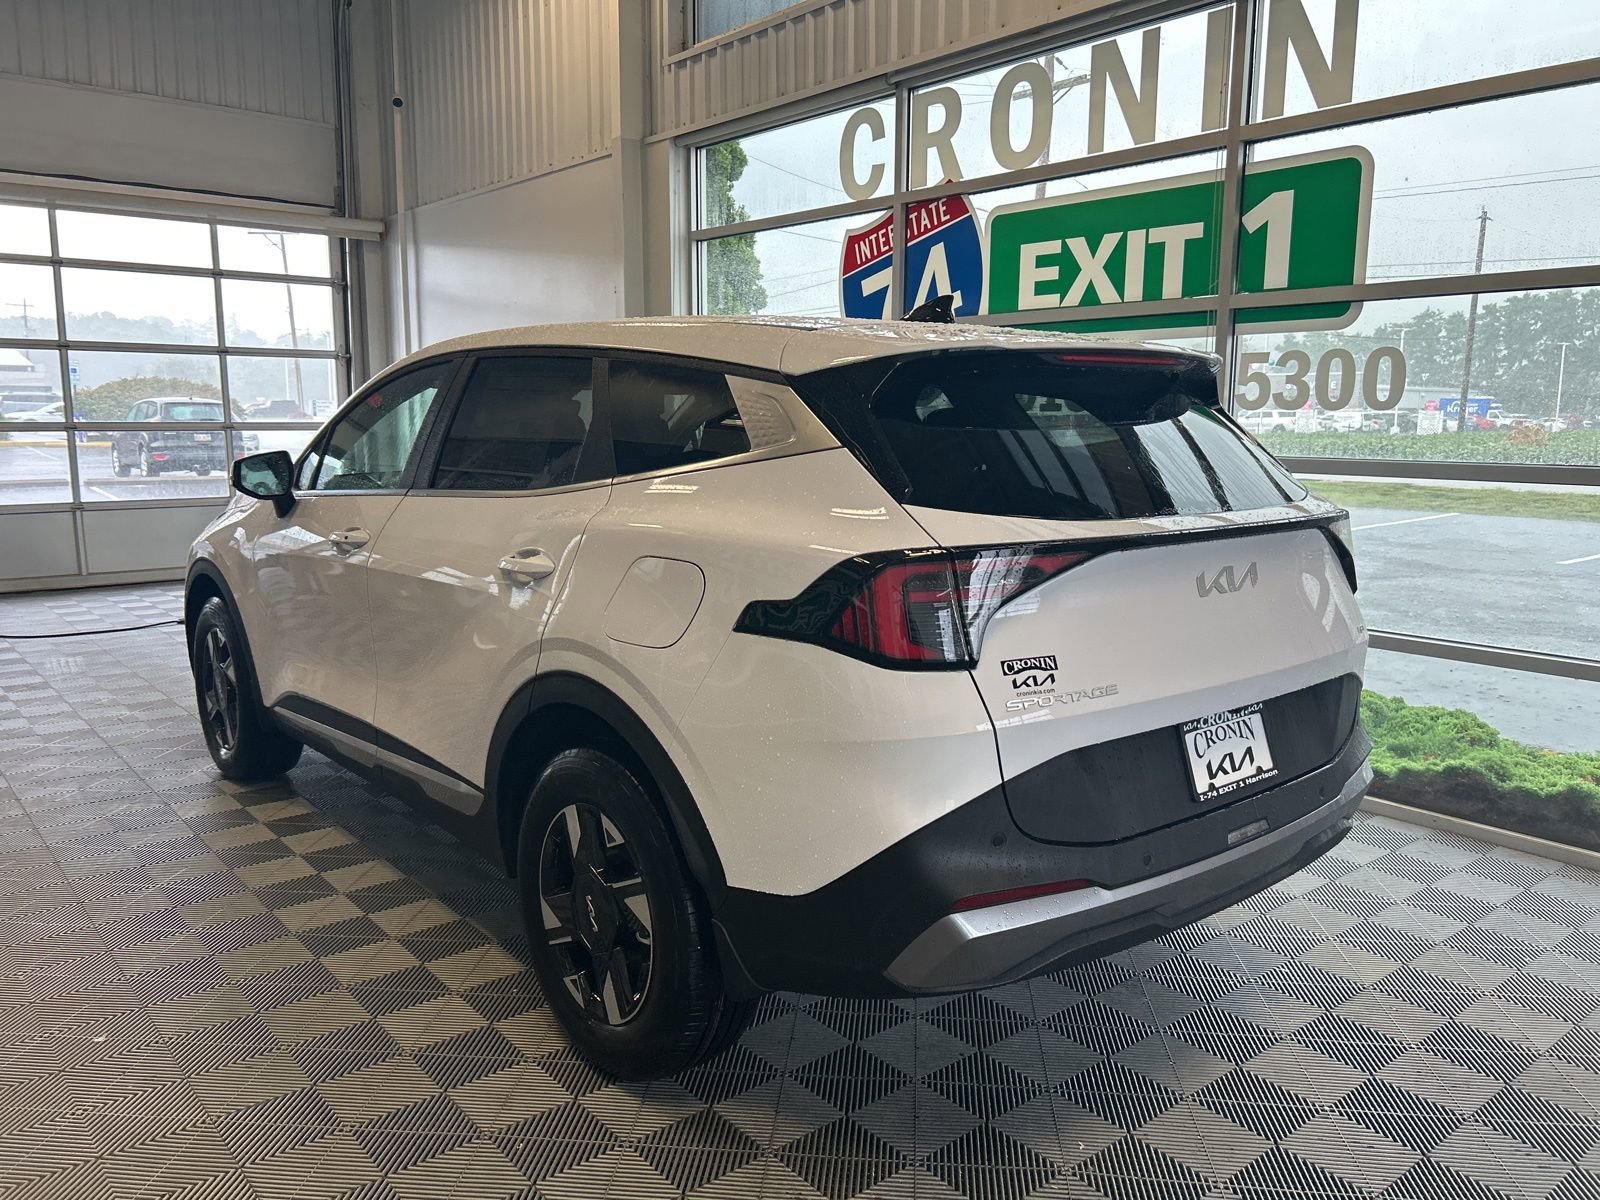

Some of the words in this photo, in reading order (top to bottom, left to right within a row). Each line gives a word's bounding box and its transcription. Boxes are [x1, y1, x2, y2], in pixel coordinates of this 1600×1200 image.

[839, 0, 1361, 201] CRONIN
[854, 198, 951, 265] INTETATE
[1018, 221, 1205, 311] EXIT
[1241, 189, 1295, 290] 1
[1234, 346, 1407, 411] 5300
[1446, 401, 1479, 416] Krer
[1003, 656, 1056, 675] CRONIN
[1006, 684, 1119, 712] SPORTAGE
[1016, 688, 1056, 698] croninkia.com
[1193, 717, 1256, 759] CRONIN
[1219, 783, 1237, 795] EXIT
[1246, 769, 1278, 785] Harrison
